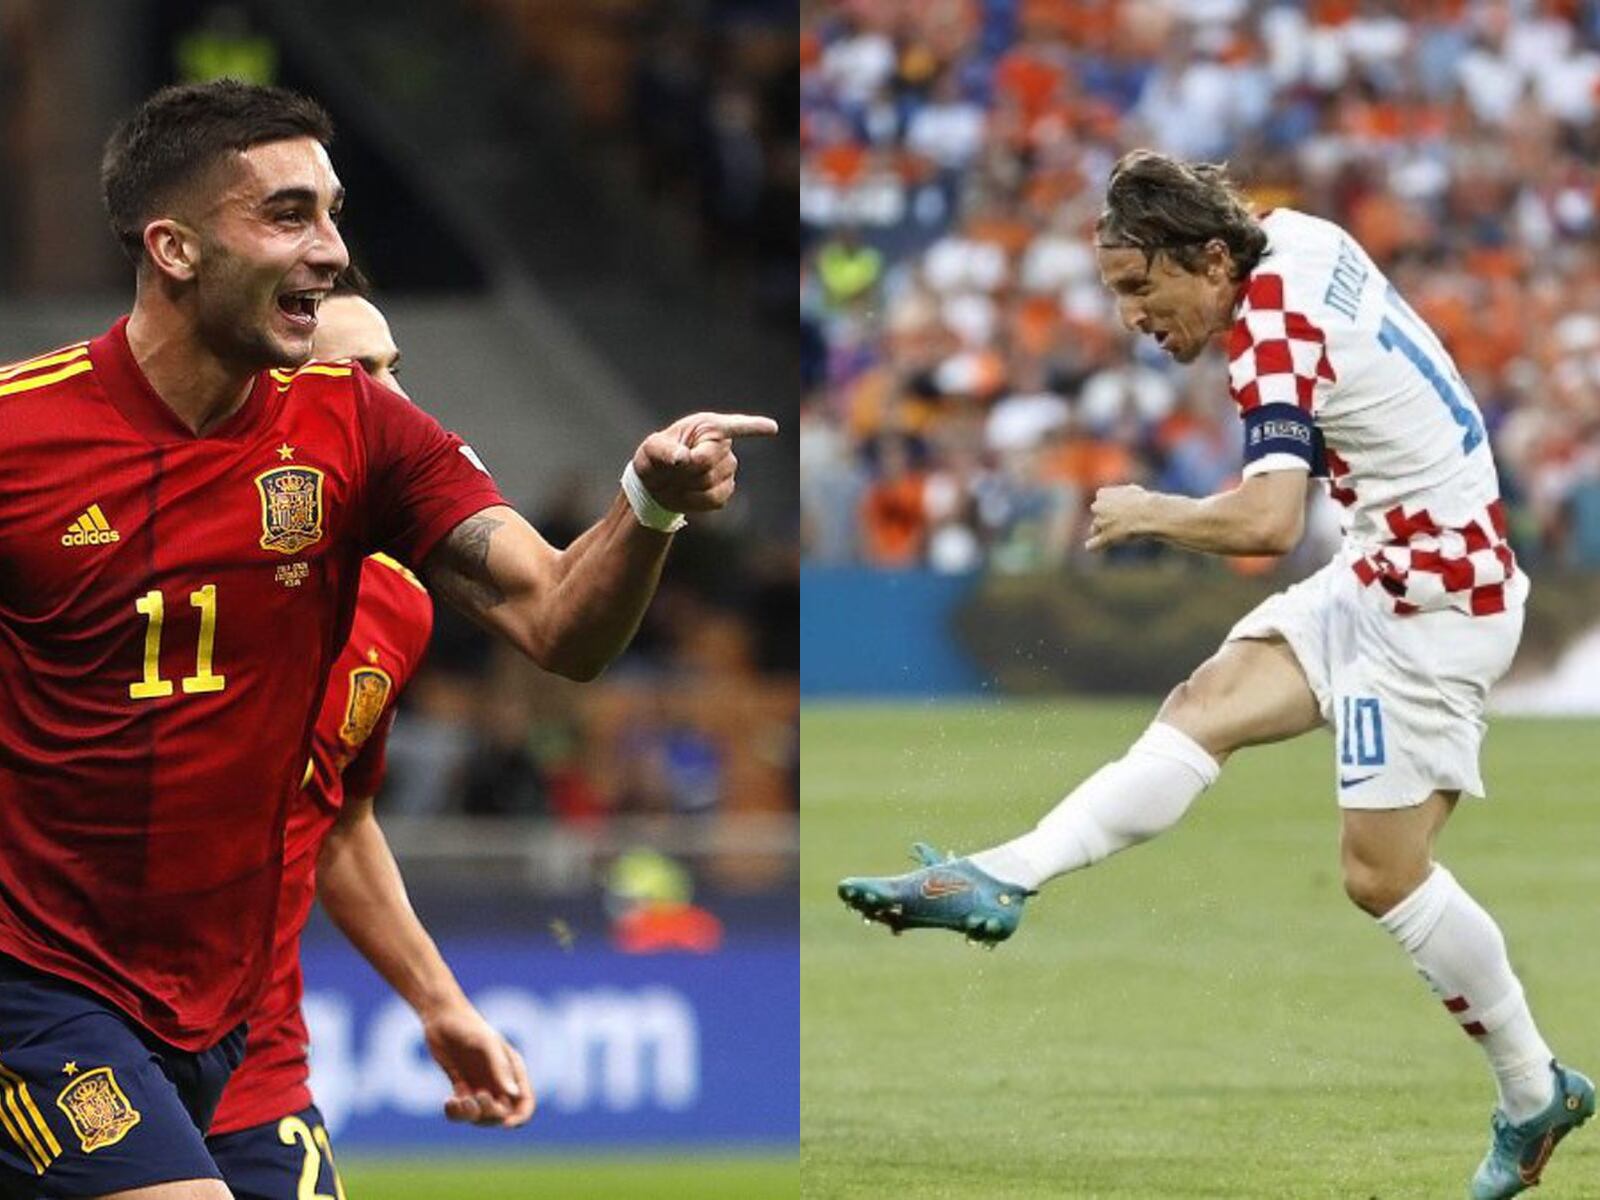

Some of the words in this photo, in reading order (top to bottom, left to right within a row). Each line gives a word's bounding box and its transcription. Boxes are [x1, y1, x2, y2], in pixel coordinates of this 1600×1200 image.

[1376, 284, 1483, 456] 1
[61, 530, 121, 547] adidas
[129, 584, 226, 699] 11
[1341, 695, 1386, 766] 10
